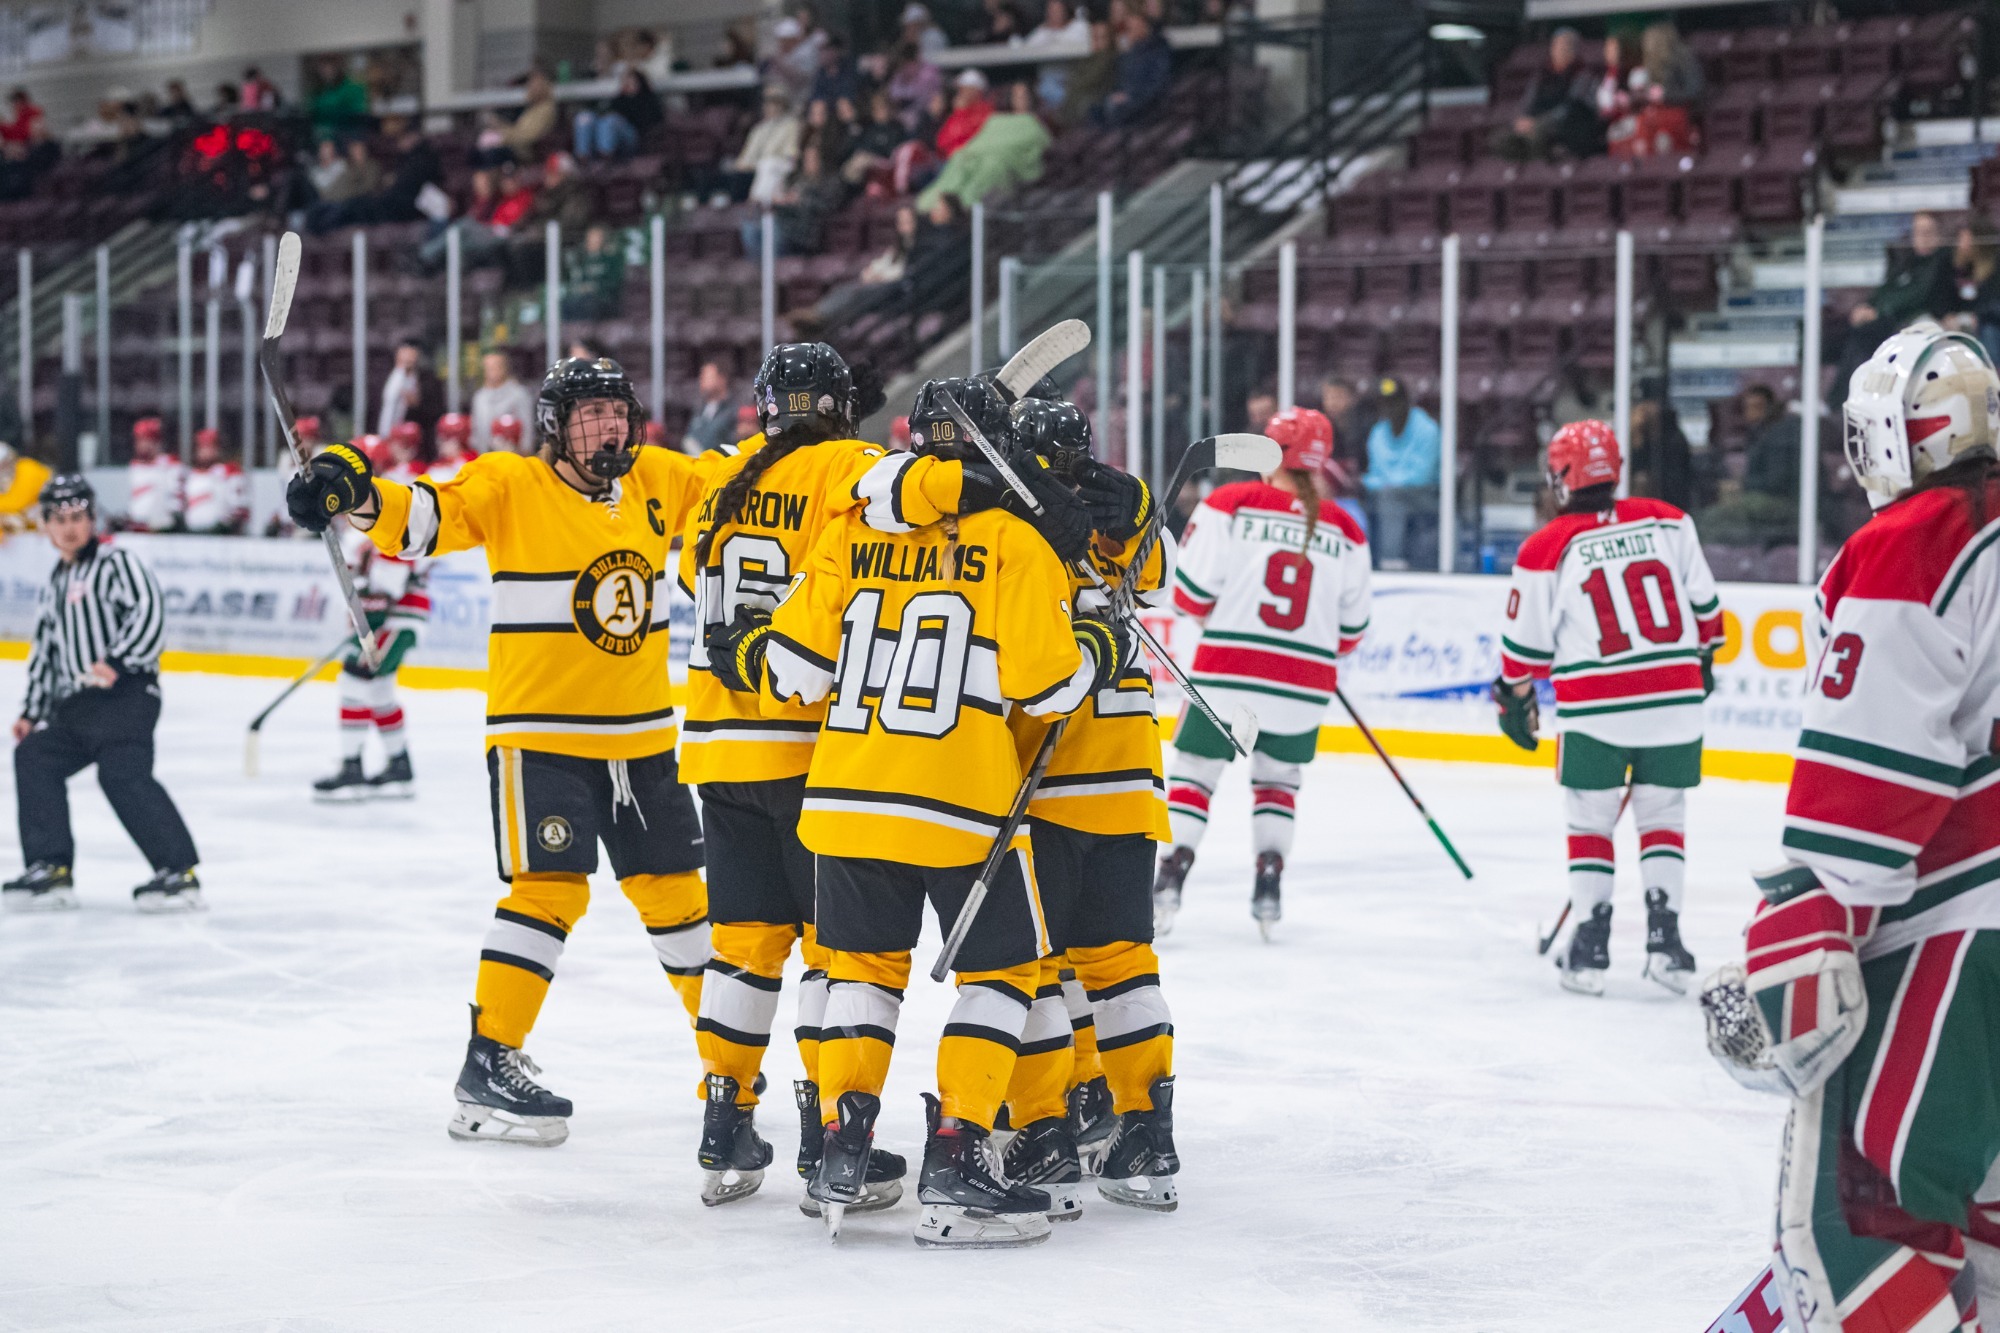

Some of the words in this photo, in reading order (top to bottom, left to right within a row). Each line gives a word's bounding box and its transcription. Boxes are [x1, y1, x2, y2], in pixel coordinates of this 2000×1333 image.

[788, 392, 811, 411] 16
[931, 421, 955, 442] 10
[646, 498, 665, 537] C
[1579, 533, 1656, 566] SCHMIDT
[589, 552, 652, 581] BULLDOGS
[164, 587, 279, 620] CASE
[576, 601, 592, 610] EST
[604, 574, 641, 629] A
[1258, 549, 1314, 632] 9
[1579, 558, 1684, 658] 10
[826, 587, 976, 741] 10
[1812, 632, 1865, 701] 3
[1181, 683, 1219, 723] WARRIOR
[1127, 1148, 1152, 1173] CCM
[968, 1178, 1007, 1198] BAUER
